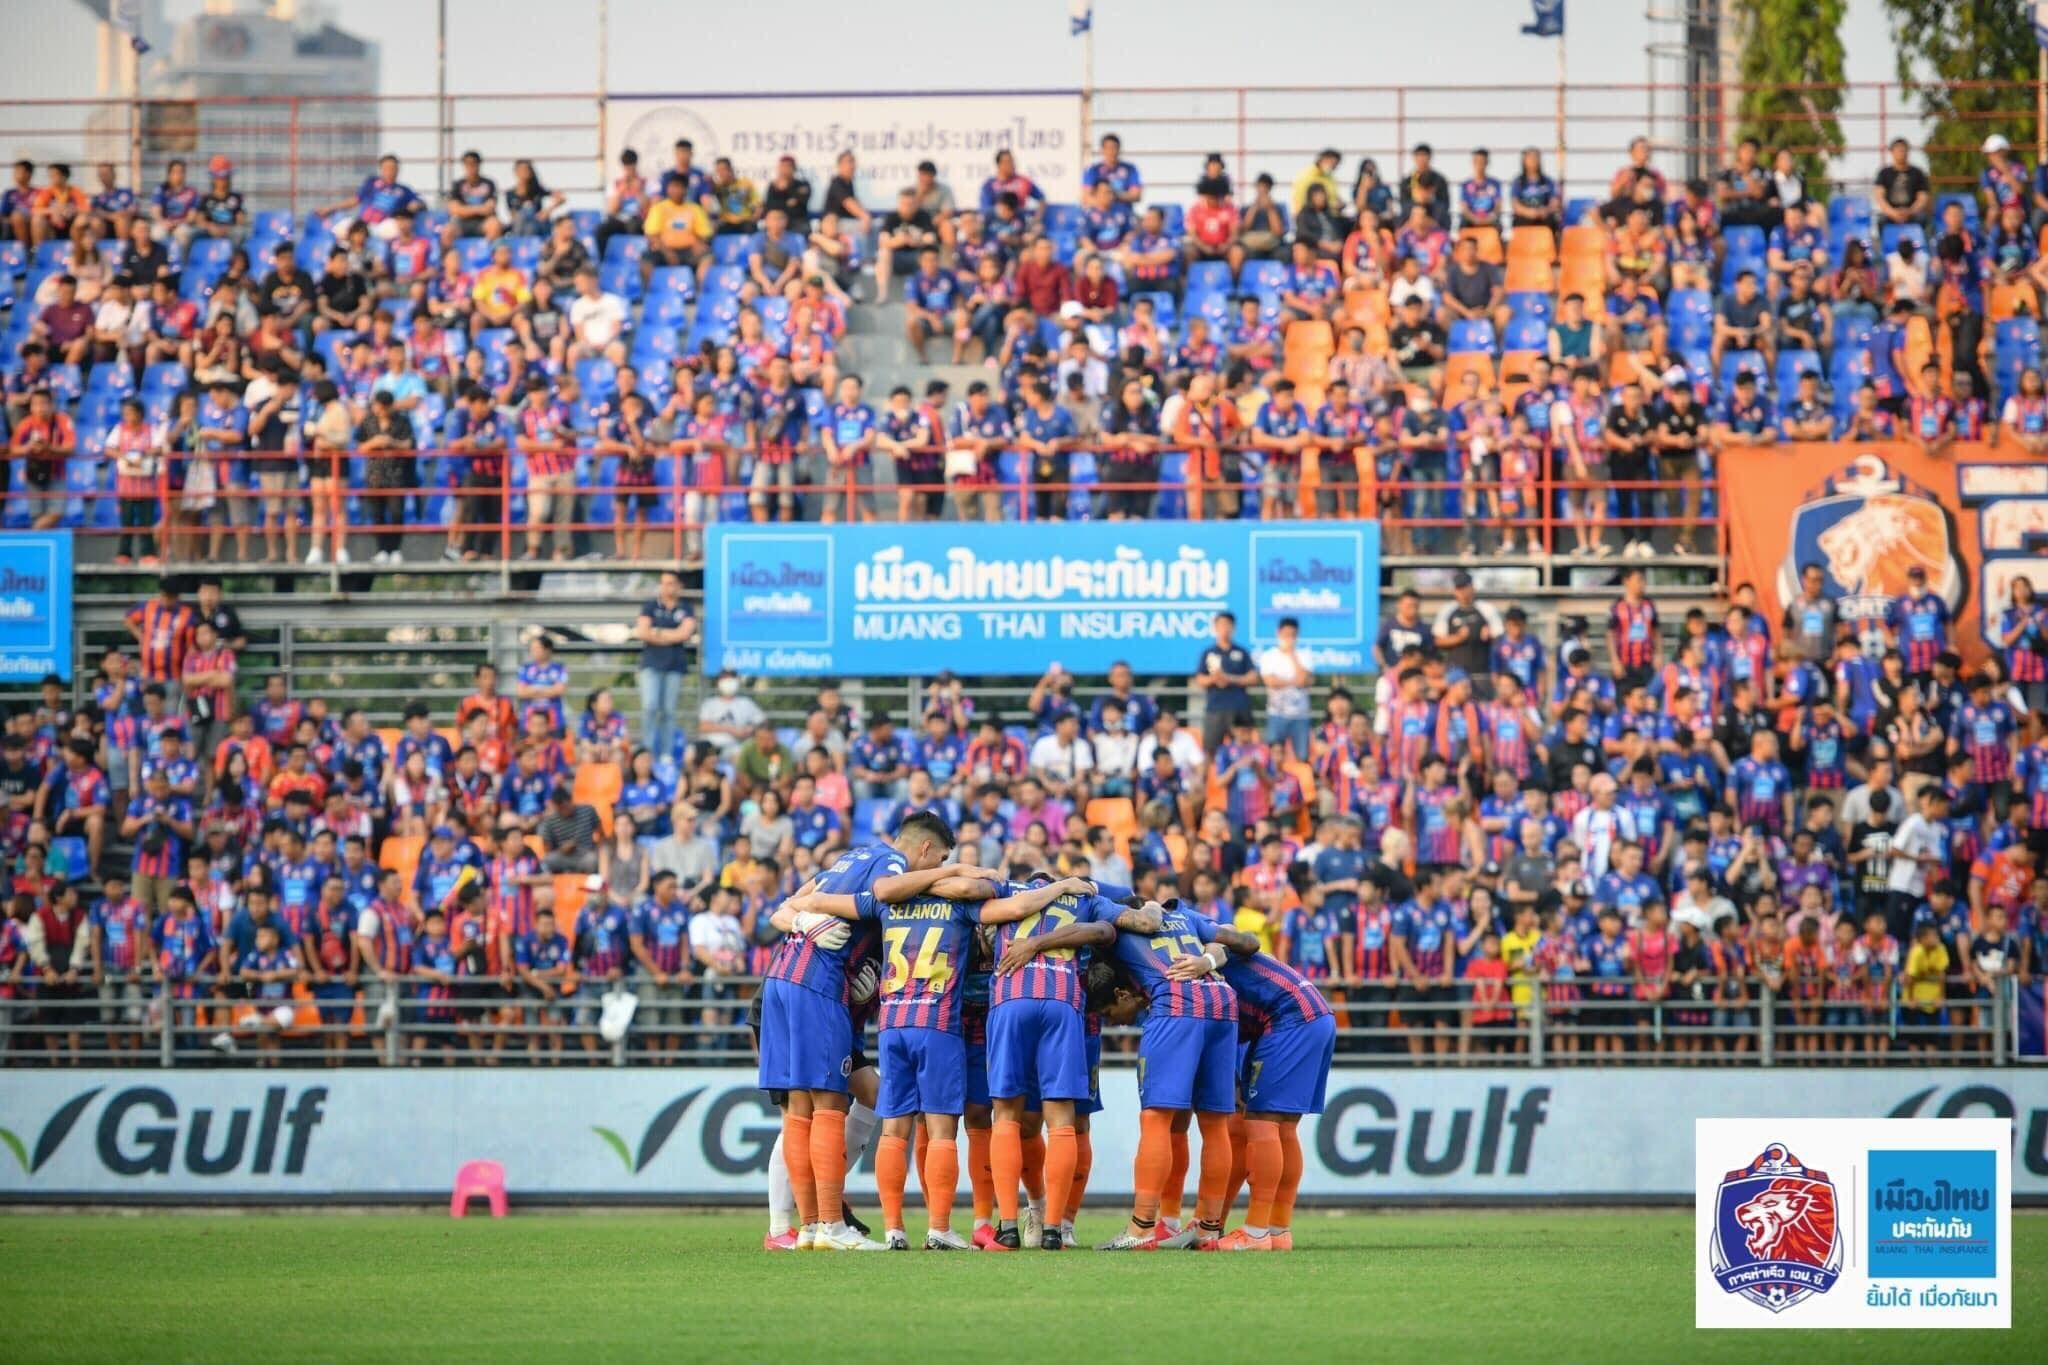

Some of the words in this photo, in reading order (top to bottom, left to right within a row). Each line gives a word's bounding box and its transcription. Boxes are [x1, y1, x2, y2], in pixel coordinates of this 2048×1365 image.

[854, 545, 1229, 600] เมืองไทยประกันภัย
[853, 613, 962, 641] MUANG
[982, 613, 1045, 640] THAI
[888, 903, 952, 920] SELANON
[883, 926, 955, 994] 34
[95, 1086, 330, 1176] Gulf
[1315, 1086, 1551, 1177] Gulf
